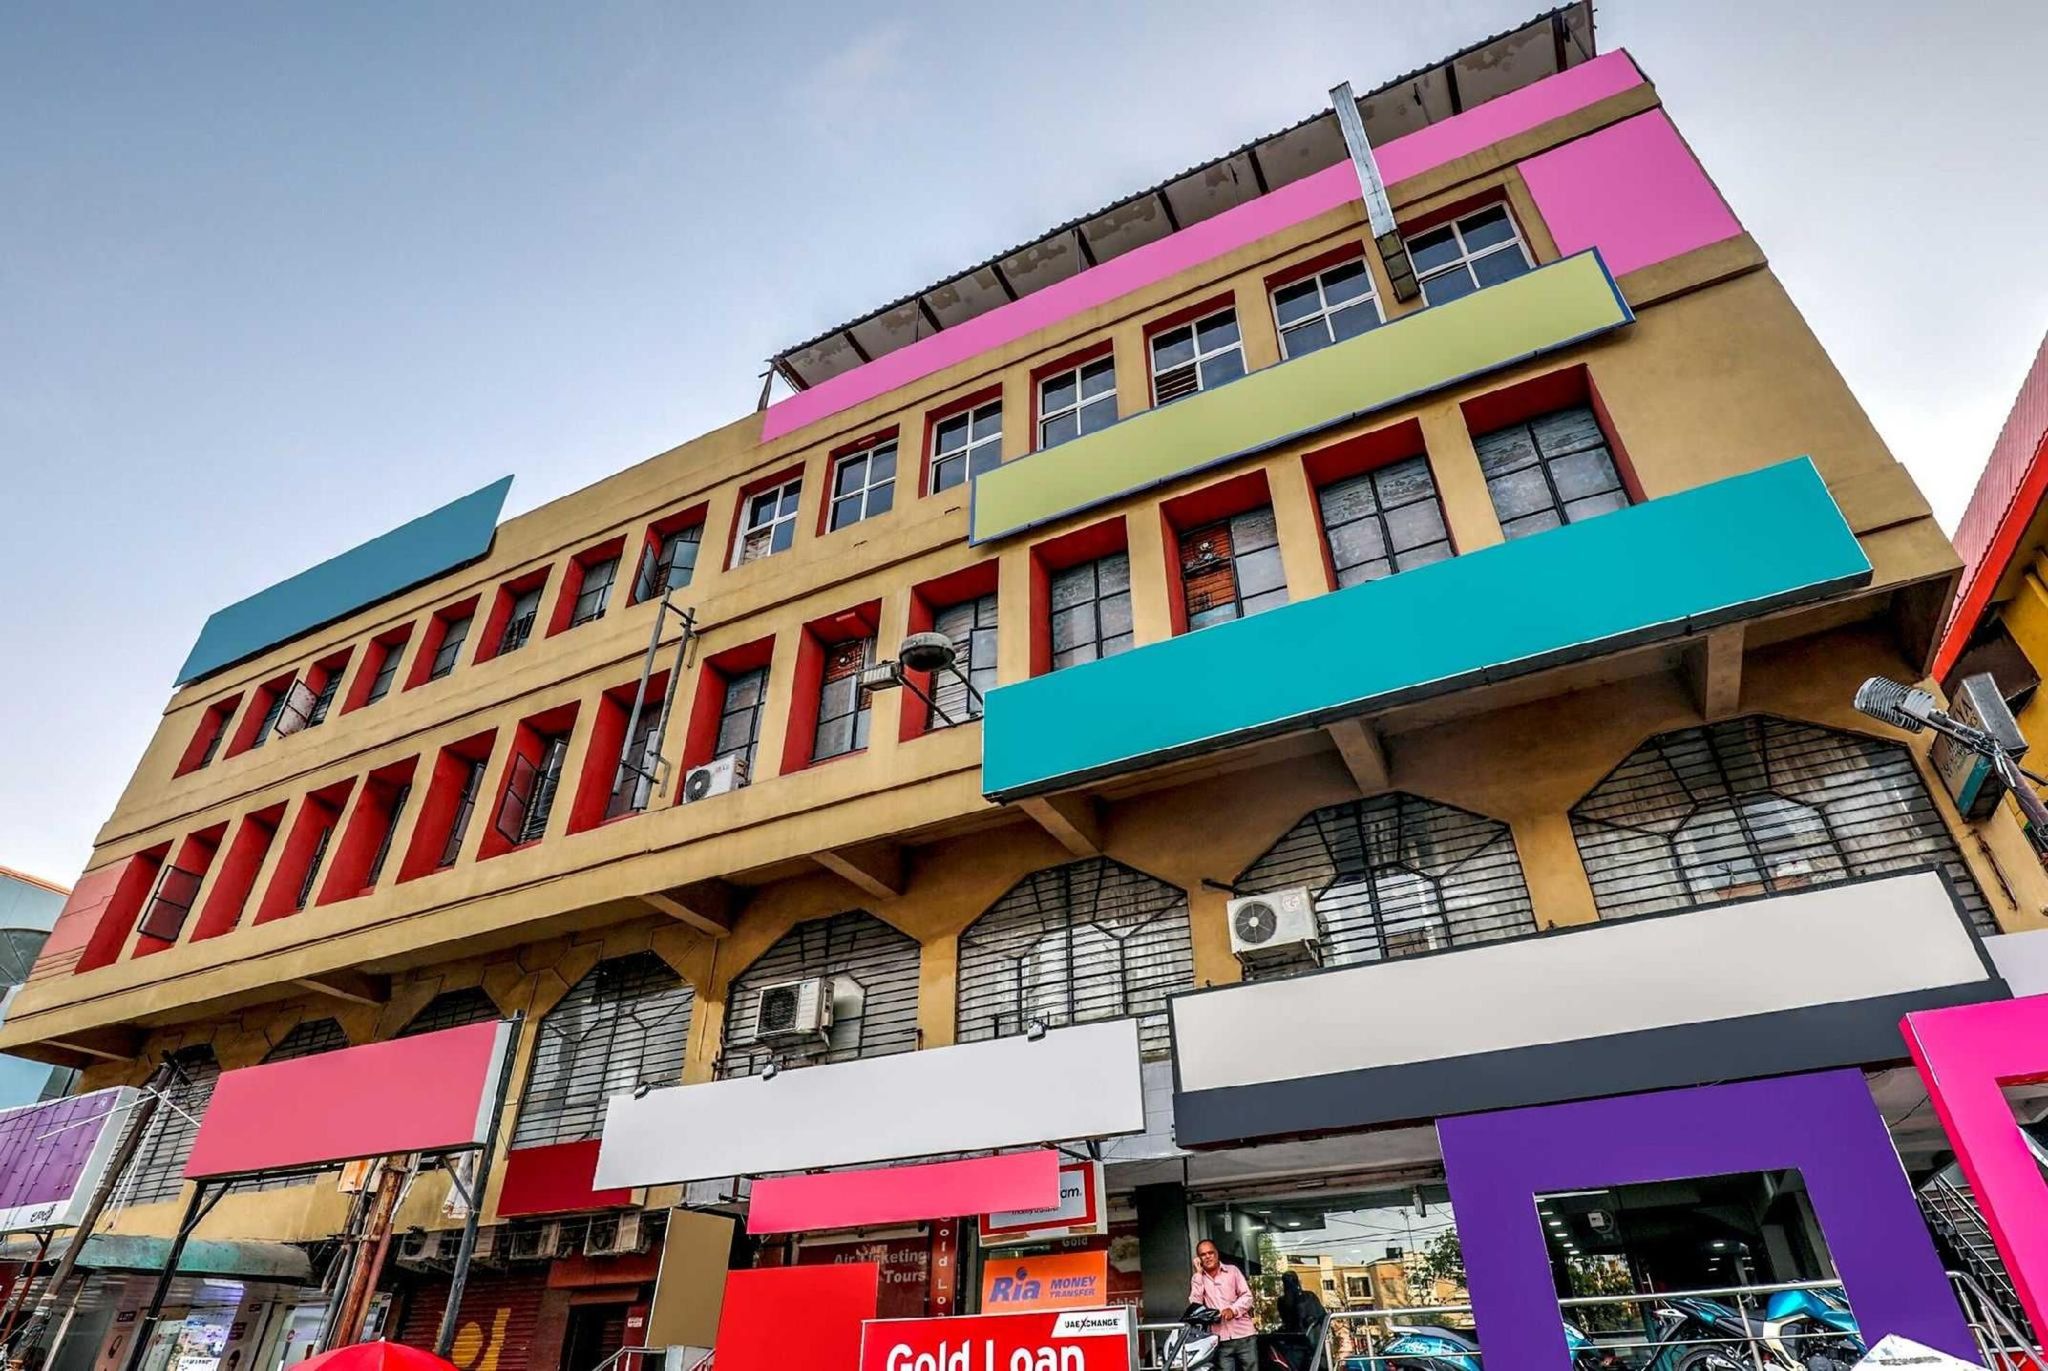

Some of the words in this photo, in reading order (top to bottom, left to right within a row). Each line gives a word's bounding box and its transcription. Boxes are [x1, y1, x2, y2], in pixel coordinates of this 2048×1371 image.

[1062, 1237, 1089, 1248] Gold
[883, 1270, 927, 1284] Tours
[988, 1267, 1041, 1303] Ria
[1050, 1276, 1096, 1290] MONEY
[1050, 1287, 1095, 1299] TRANSFER
[886, 1339, 970, 1371] Gold
[985, 1339, 1085, 1371] Loan
